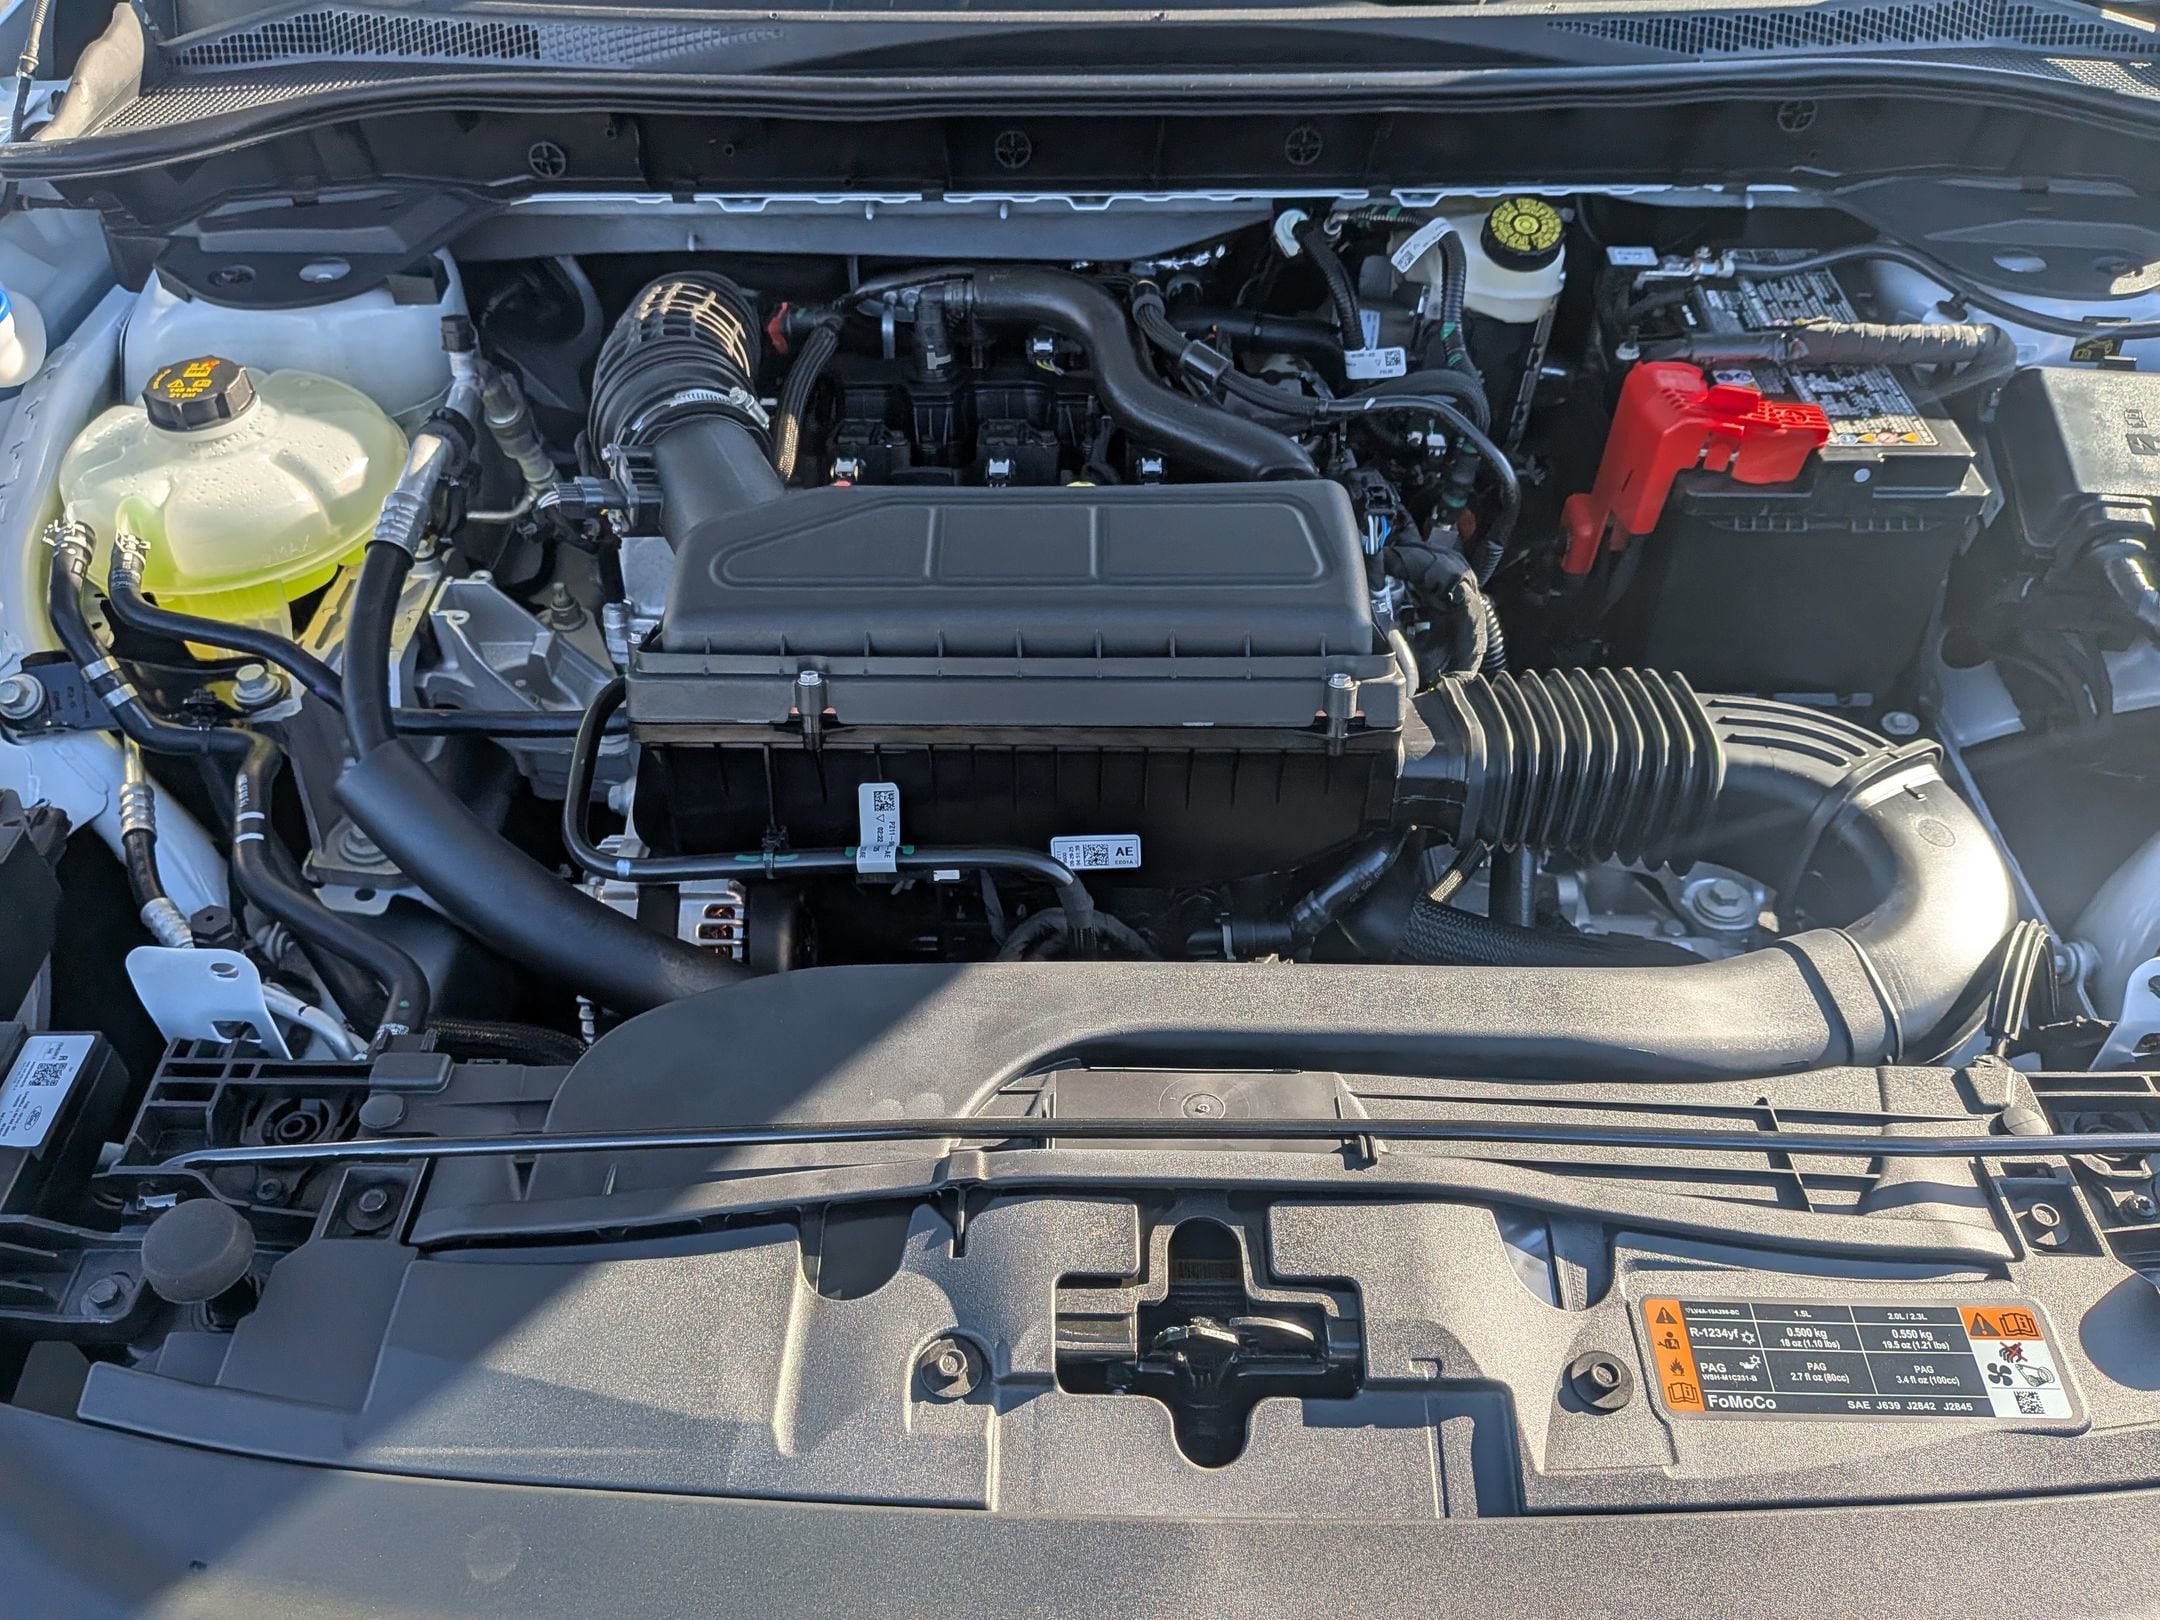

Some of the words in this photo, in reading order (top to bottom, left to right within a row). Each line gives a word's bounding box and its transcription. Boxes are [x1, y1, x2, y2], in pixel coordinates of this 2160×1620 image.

[1115, 847, 1134, 856] AE
[1794, 1310, 1812, 1318] 1.5L
[1909, 1313, 1928, 1321] 2.3L
[1689, 1327, 1739, 1340] R-1234yf
[1786, 1327, 1813, 1337] 0.500
[1814, 1327, 1828, 1340] kg
[1891, 1329, 1918, 1339] 0.550
[1919, 1330, 1933, 1341] kg
[1780, 1338, 1791, 1347] 18
[1803, 1339, 1823, 1349] (1.10
[1823, 1339, 1841, 1350] lbs)
[1882, 1341, 1900, 1349] 19.5
[1912, 1341, 1932, 1351] (1.21
[1933, 1341, 1950, 1351] lbs)
[1700, 1362, 1727, 1373] PAG
[1806, 1362, 1827, 1371] PAG
[1914, 1365, 1935, 1374] PAG
[1790, 1372, 1803, 1381] 2.7
[1804, 1372, 1812, 1381] fl
[1812, 1374, 1823, 1382] oz
[1823, 1373, 1850, 1384] (80cc)
[1896, 1375, 1909, 1384] 3.4
[1910, 1375, 1918, 1384] fl
[1929, 1375, 1961, 1387] (100cc)
[1707, 1394, 1777, 1410] FoMoCo
[1847, 1400, 1872, 1410] SAE
[1876, 1401, 1901, 1411] J639
[1906, 1401, 1937, 1411] J2842
[1943, 1402, 1974, 1412] J2845
